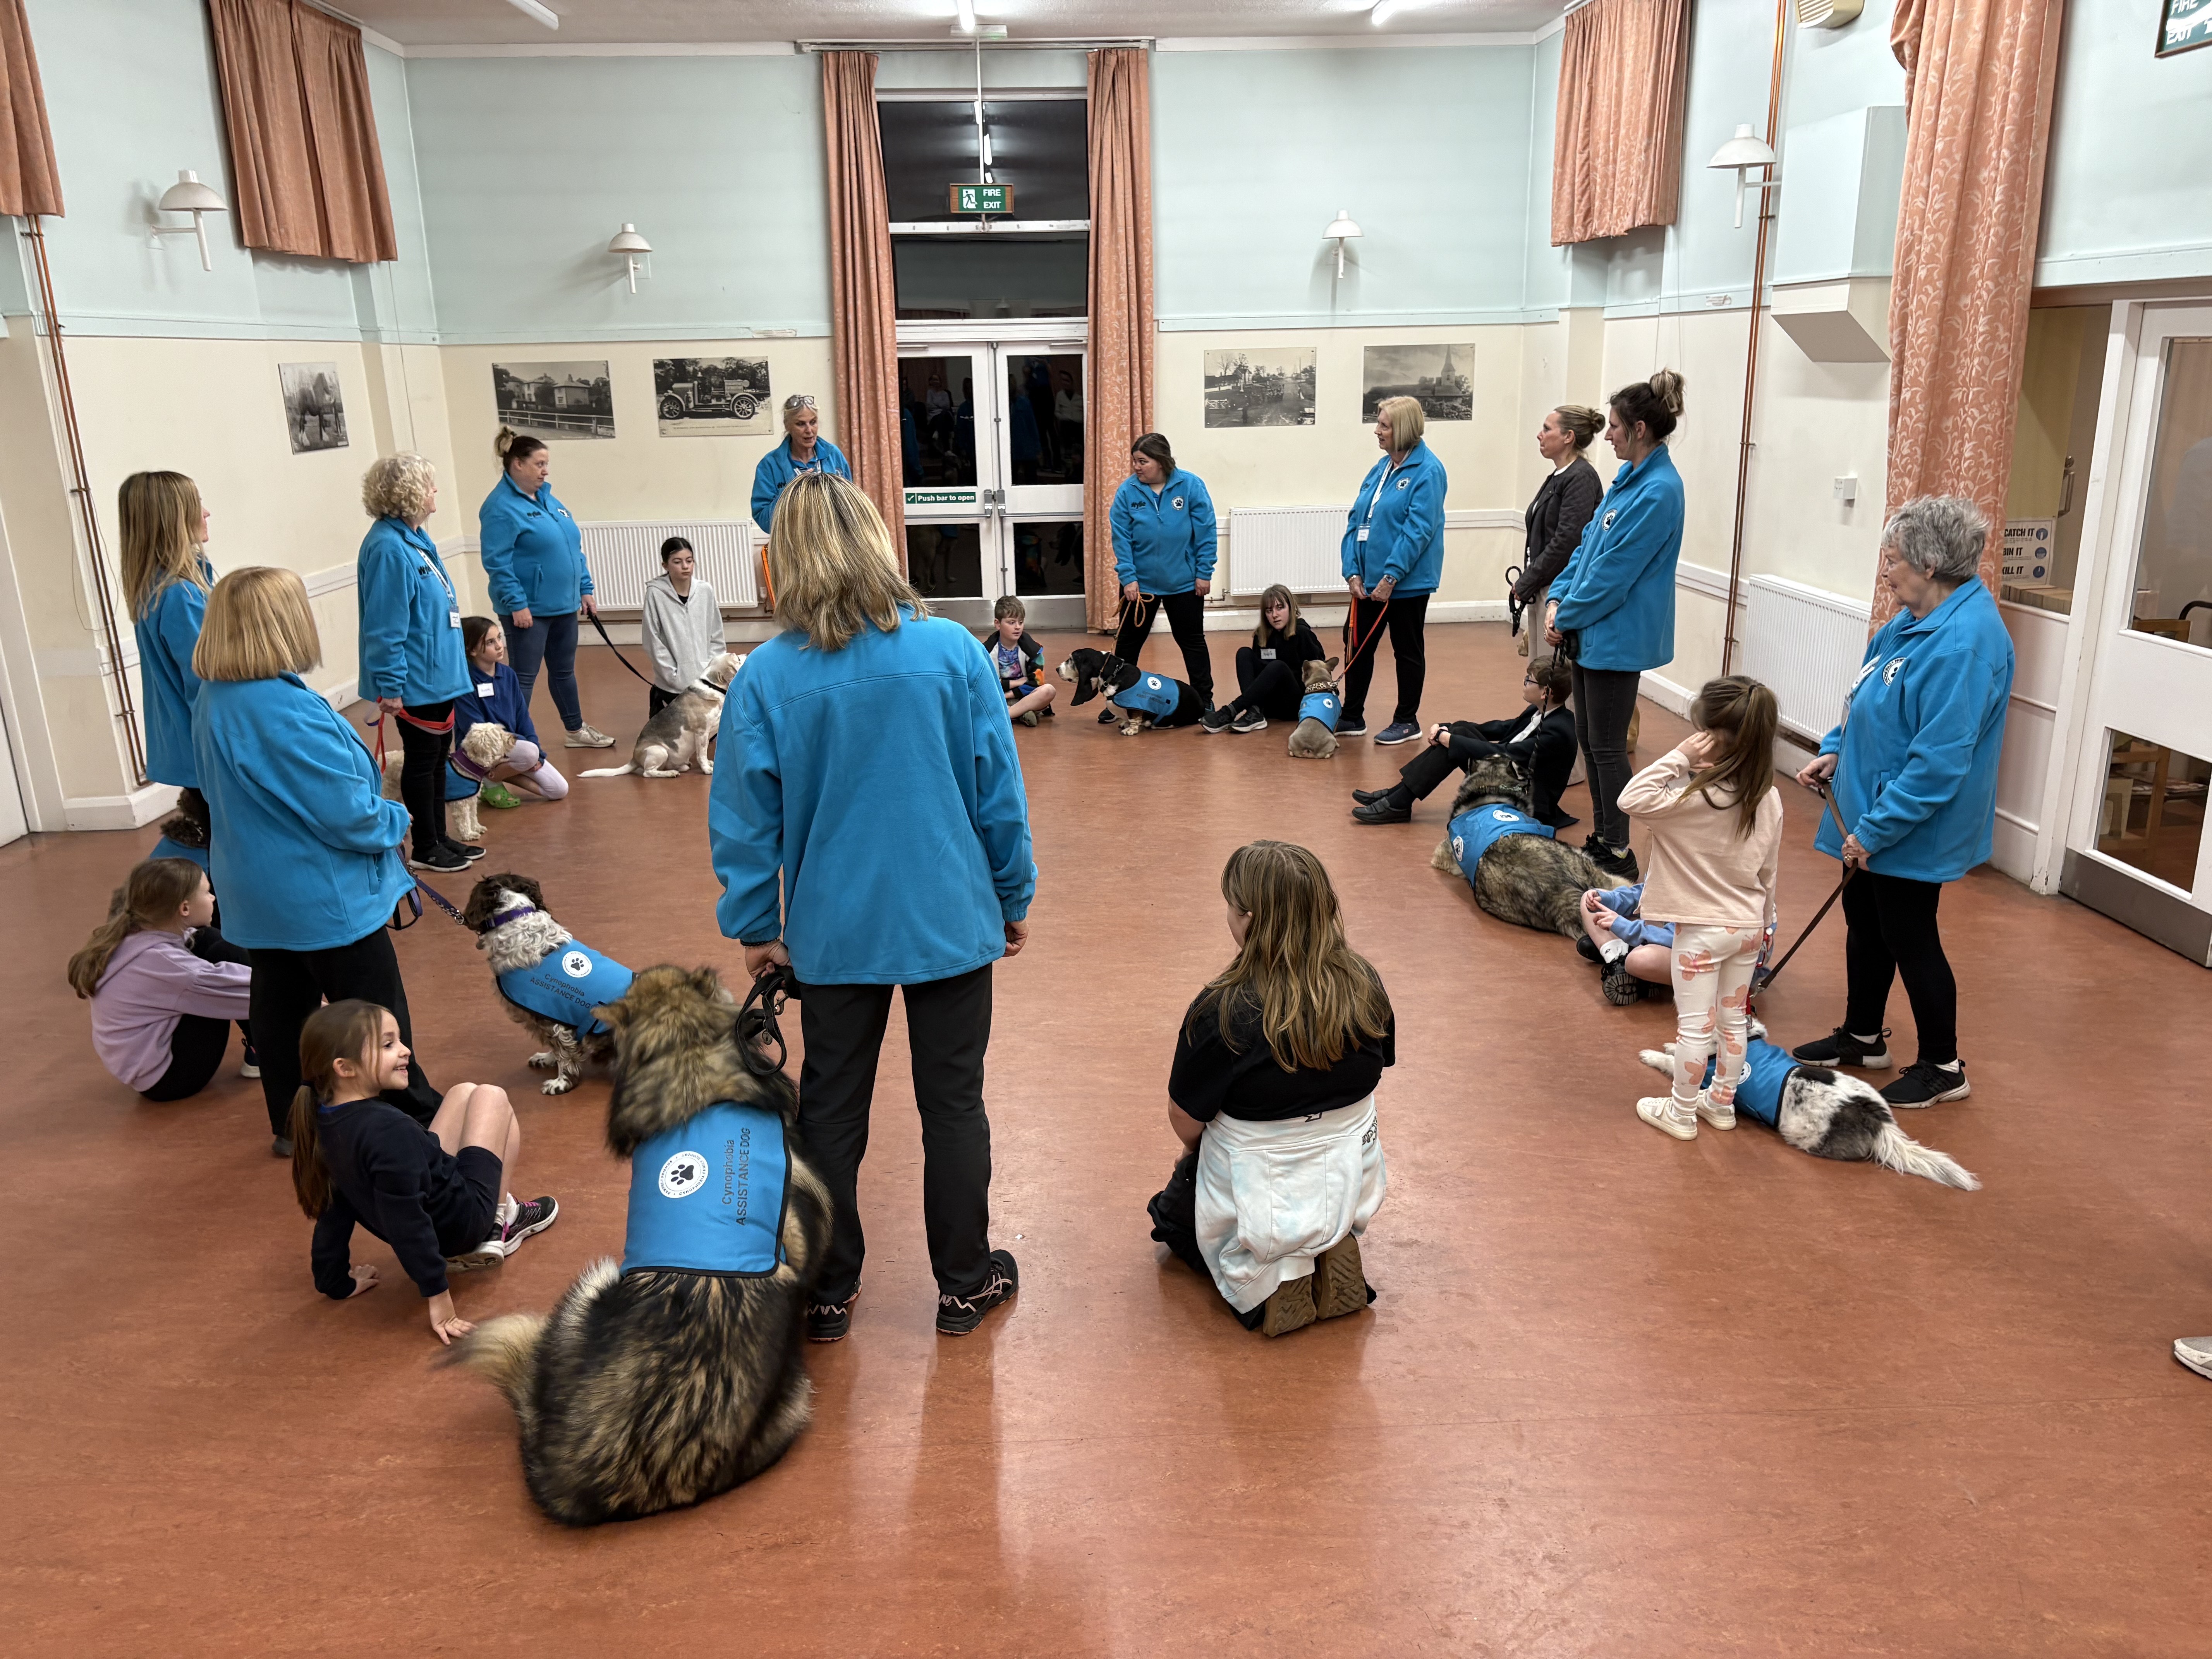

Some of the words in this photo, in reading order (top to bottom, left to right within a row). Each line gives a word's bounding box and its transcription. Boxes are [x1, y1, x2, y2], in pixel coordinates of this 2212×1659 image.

[2004, 528, 2026, 537] CATCH
[2028, 528, 2035, 536] IT
[2016, 566, 2024, 574] IT
[530, 977, 575, 1001] ASSISTANCE
[575, 998, 591, 1008] DOG
[545, 974, 584, 996] Cynophobia
[740, 1127, 750, 1149] DOG
[722, 1140, 734, 1205] Cynophobia
[736, 1149, 749, 1226] ASSISTANCE
